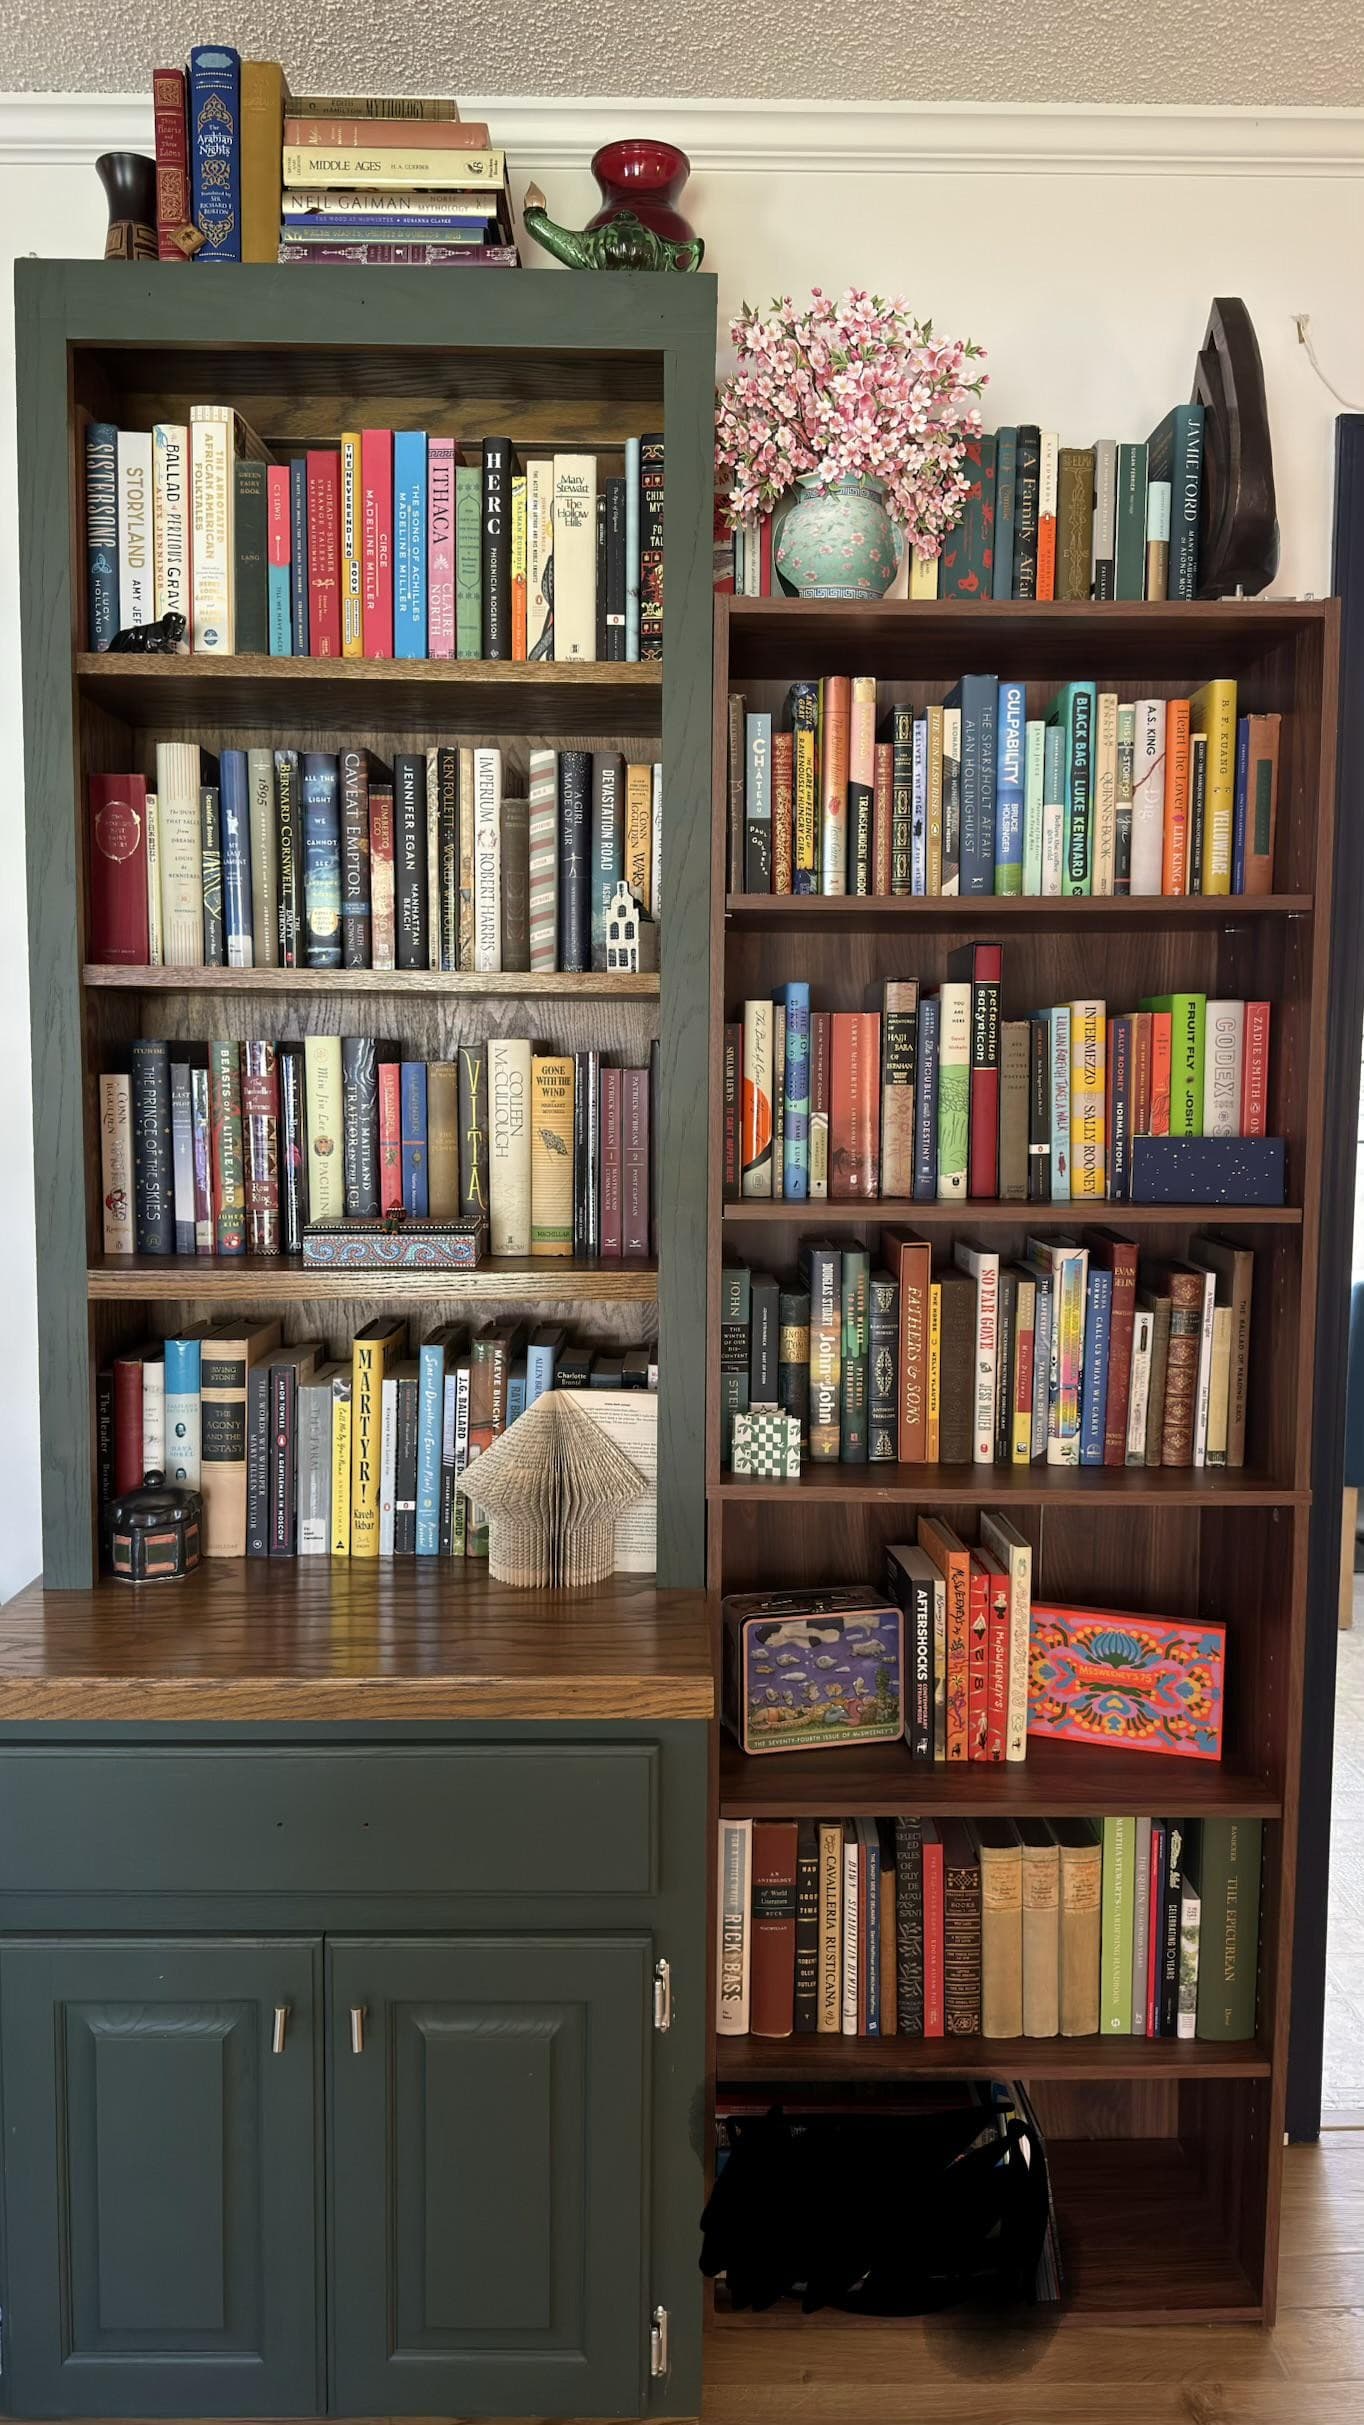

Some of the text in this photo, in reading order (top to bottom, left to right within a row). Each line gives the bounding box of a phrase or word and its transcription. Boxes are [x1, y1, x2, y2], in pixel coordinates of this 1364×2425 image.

[198, 132, 233, 145] Arabian
[366, 98, 424, 118] MYTHOLOGY
[200, 144, 230, 157] Nights
[309, 160, 381, 170] MIDDLE AGES
[292, 195, 410, 210] NEIL GAIMAN
[86, 444, 116, 548] SISTERSONG
[166, 444, 181, 502] BALLAD
[194, 462, 204, 531] FOLKTALES
[204, 432, 214, 560] AFRICAN AMERICAN
[1184, 418, 1200, 521] JAMIE FORD
[126, 466, 145, 568] STORYLAND
[166, 513, 183, 562] PERILOUS
[432, 466, 450, 546] ITHACA
[1020, 478, 1036, 542] Family
[366, 489, 376, 610] MADELINE MILLER
[380, 534, 388, 568] CIRCE
[399, 492, 408, 613] MADELINE MILLER
[412, 484, 421, 622] THE SONG OF ACHILLES
[94, 580, 102, 634] HOLLAND
[102, 592, 110, 622] LUCY
[132, 580, 142, 600] AMY
[431, 584, 441, 636] NORTH
[442, 583, 453, 637] CLAIRE
[490, 547, 498, 640] PHOENICIA ROGERSON
[1004, 689, 1020, 784] CULPABILITY
[1146, 706, 1156, 756] A.S. KING
[1220, 732, 1230, 775] KUANG
[256, 778, 268, 806] 1895
[798, 738, 806, 794] RAVENOUSLY
[964, 720, 976, 854] ALAN HOLLINGHURST
[980, 706, 993, 858] THE SPARSHOLT AFFAIR
[1072, 698, 1088, 877] BLACK BAG LUKE KENNARD
[1172, 708, 1189, 882] Heart the Lover LILY KING
[280, 764, 293, 896] BERNARD CORNWELL
[345, 753, 361, 898] CAVEAT EMPTOR
[404, 765, 415, 870] JENNIFER EGAN
[444, 756, 454, 885] KEN FOLLETT WORLD
[600, 769, 614, 870] DEVASTATION ROAD
[639, 810, 649, 840] CONN
[857, 795, 868, 859] TRANSCENDENT
[1001, 803, 1010, 853] HOLSINGER
[1010, 803, 1018, 832] BRUCE
[1100, 770, 1113, 859] QUINN'S BOOK
[1211, 810, 1230, 875] YELLOWFACE
[479, 756, 495, 951] IMPERIUM ROBERT HARRIS
[402, 898, 411, 931] BEACH
[410, 883, 420, 946] MANHATTAN
[850, 1018, 858, 1100] LARRY McMURTRY
[888, 1034, 906, 1042] HAJJI
[894, 1044, 914, 1052] BABA
[1185, 1002, 1196, 1126] FRUIT FLY JOSH
[1213, 1017, 1236, 1098] CODEX
[1252, 1016, 1264, 1098] ZADIE SMITH
[220, 1050, 230, 1096] BEASTS
[494, 1047, 509, 1158] McCULLOUGH
[509, 1070, 524, 1136] COLLEEN
[536, 1076, 572, 1086] WITH THE
[541, 1066, 566, 1076] GONE
[542, 1087, 565, 1098] WIND
[608, 1075, 616, 1110] PATRICK
[632, 1076, 640, 1111] PATRICK
[924, 1056, 932, 1100] TROUBLE
[1083, 1006, 1096, 1195] INTERMEZZO SALLY ROONEY
[1117, 1056, 1126, 1092] ROONEY
[143, 1066, 160, 1221] THE PRINCE OF THE SKIES
[223, 1126, 235, 1204] LITTLE LAND
[362, 1127, 370, 1190] MAITLAND
[922, 1120, 931, 1160] DESTINY
[1115, 1102, 1124, 1172] NORMAL PEOPLE
[730, 1280, 740, 1317] JOHN
[822, 1262, 834, 1327] DOUGLAS STUART
[980, 1268, 996, 1350] SO FAR GONE
[556, 1372, 587, 1380] Charlotte
[819, 1332, 836, 1424] John John
[906, 1285, 922, 1424] FATHERS & SONS
[458, 1376, 468, 1440] J.G. BALLARD
[492, 1350, 502, 1429] MAEVE BINCHY
[359, 1349, 373, 1504] MARTYR!
[353, 1508, 374, 1520] Kaveh
[354, 1520, 374, 1530] Akbar
[917, 1590, 928, 1681] AFTERSHOCKS
[768, 1735, 821, 1746] SEVENTY-FOURTH
[900, 1872, 919, 1880] GUY
[722, 1914, 742, 2001] RICK BASS
[826, 1856, 836, 2008] CAVALLERIA RUSTICANA
[1224, 1876, 1238, 1982] THE EPICUREAN
